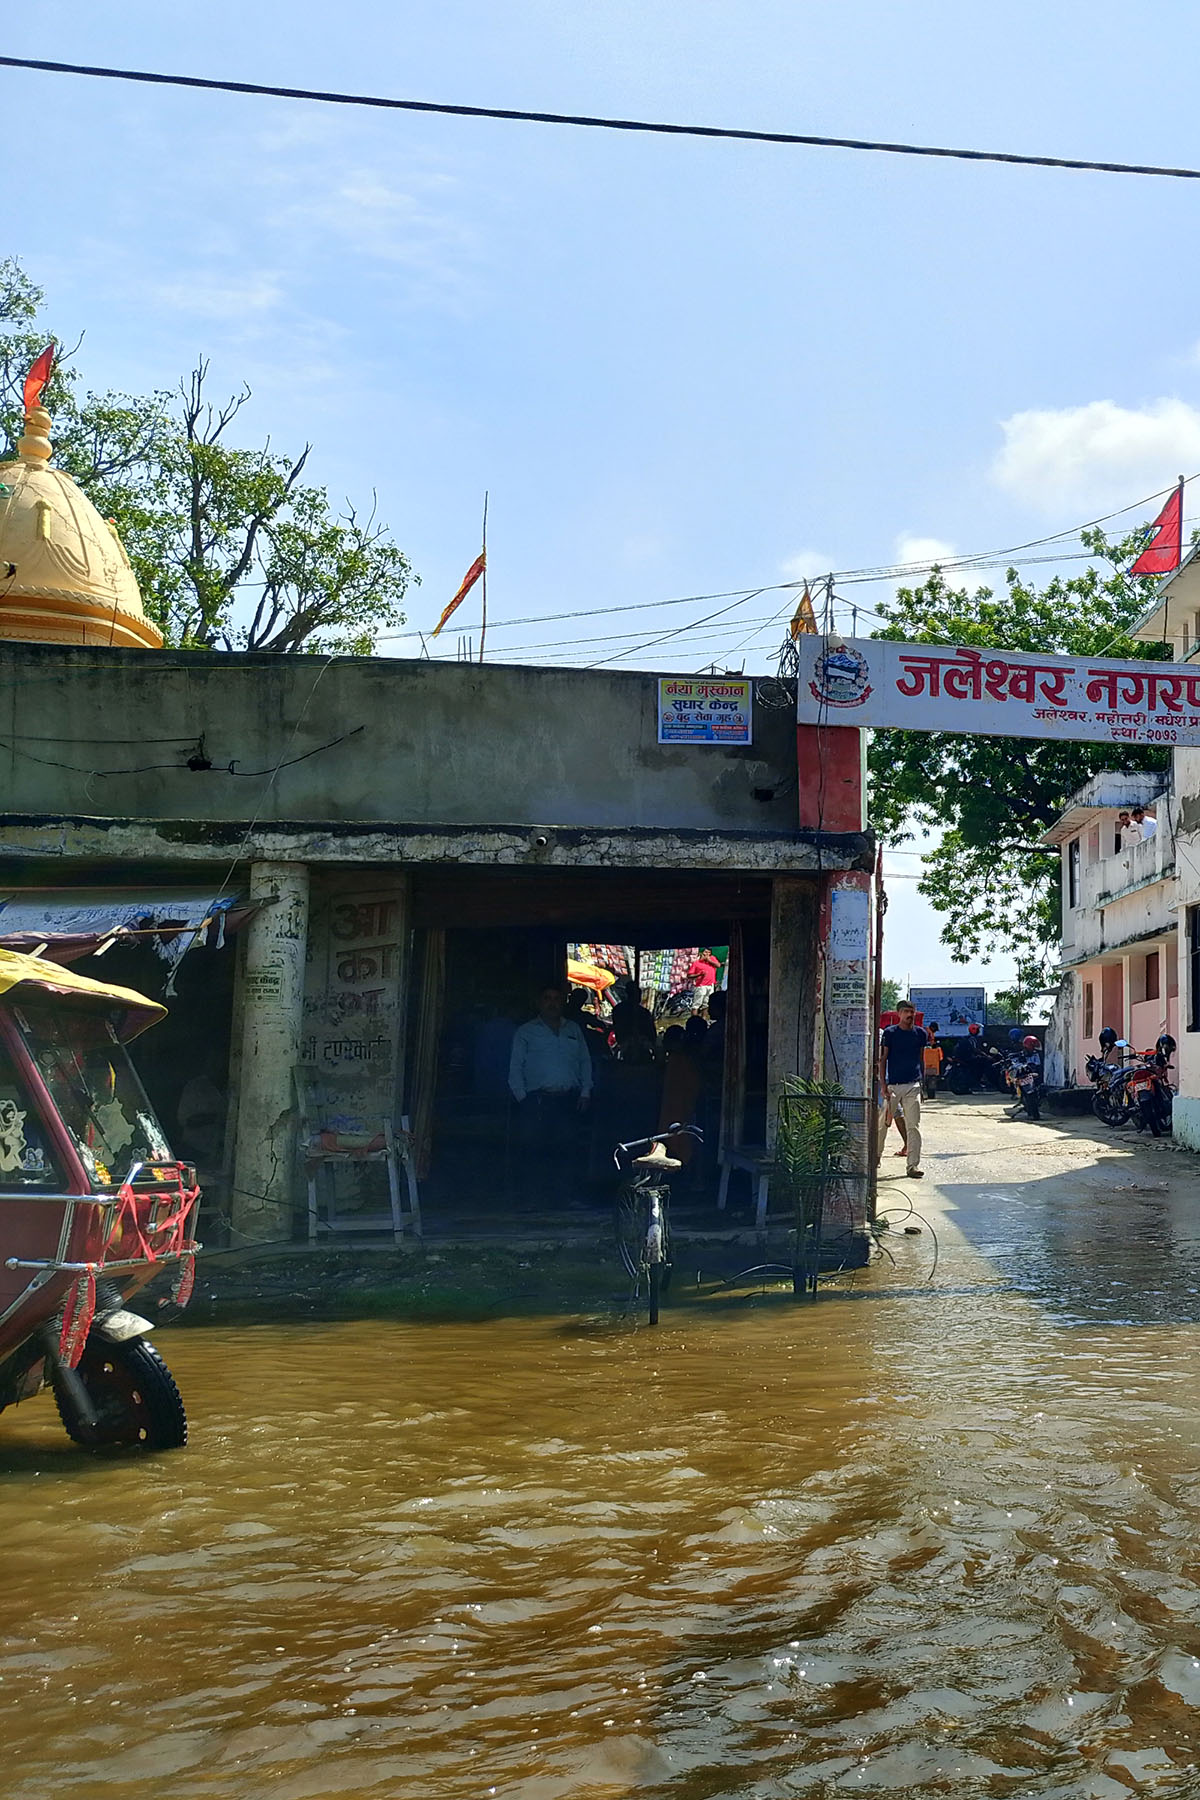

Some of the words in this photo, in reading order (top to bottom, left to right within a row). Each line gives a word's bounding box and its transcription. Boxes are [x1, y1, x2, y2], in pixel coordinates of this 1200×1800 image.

[896, 648, 1075, 707] जलेश्वर
[697, 685, 745, 699] मुस्कान
[709, 698, 738, 713] केन्द्र
[1095, 711, 1147, 727] महोत्तरी
